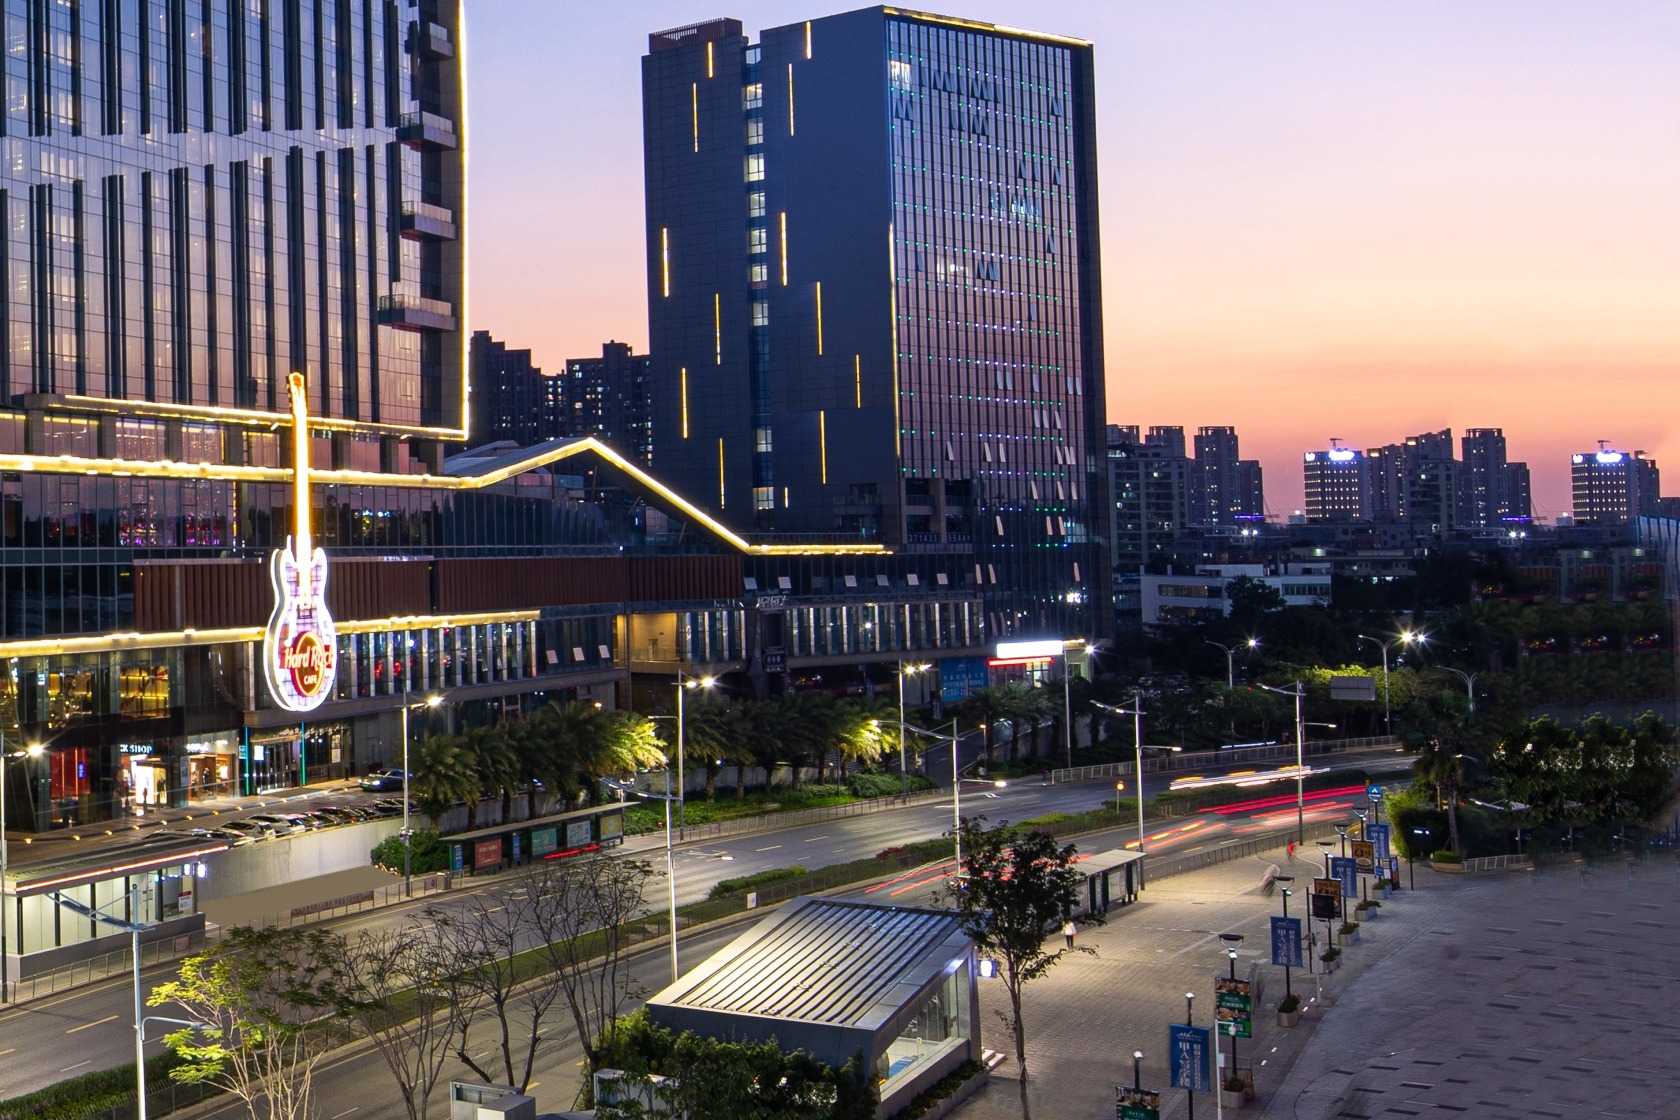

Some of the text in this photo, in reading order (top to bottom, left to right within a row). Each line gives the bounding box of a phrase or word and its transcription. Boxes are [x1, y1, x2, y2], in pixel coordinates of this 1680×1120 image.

[284, 646, 335, 671] Hard Rock
[129, 744, 152, 754] SHOP
